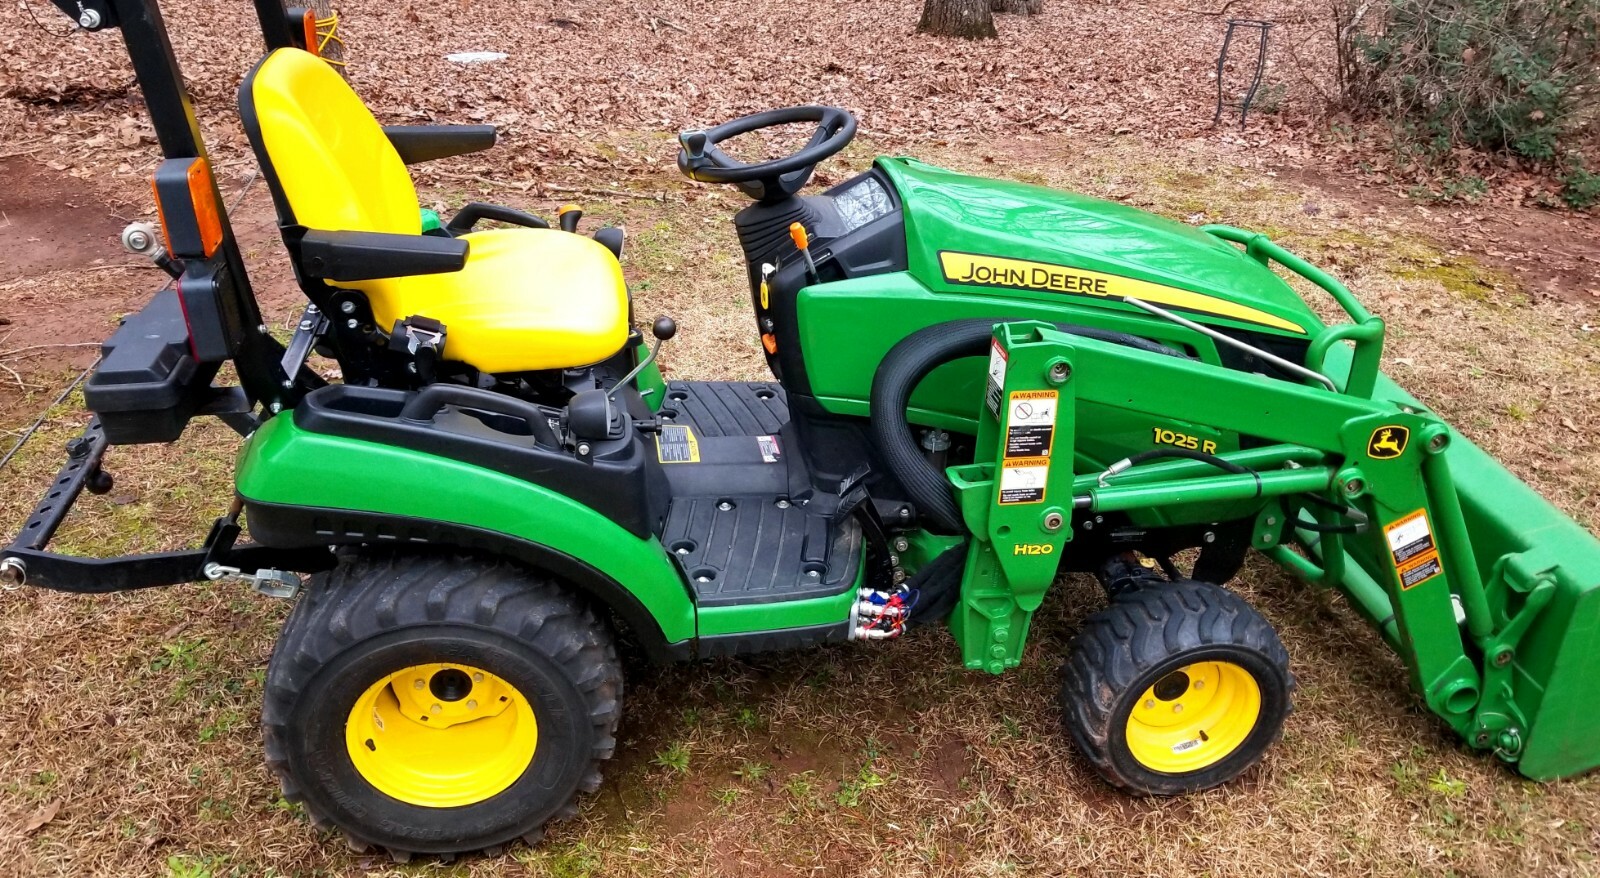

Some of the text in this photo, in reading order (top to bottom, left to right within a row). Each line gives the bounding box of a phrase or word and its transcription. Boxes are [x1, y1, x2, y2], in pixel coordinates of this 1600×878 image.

[961, 262, 1108, 294] JOHN DEERE
[1020, 391, 1056, 399] WARNING
[1153, 427, 1217, 455] 1025 R
[1012, 459, 1047, 467] WARNING
[1395, 512, 1421, 527] WARNING
[1014, 543, 1054, 556] H120
[1408, 554, 1434, 568] WARNING
